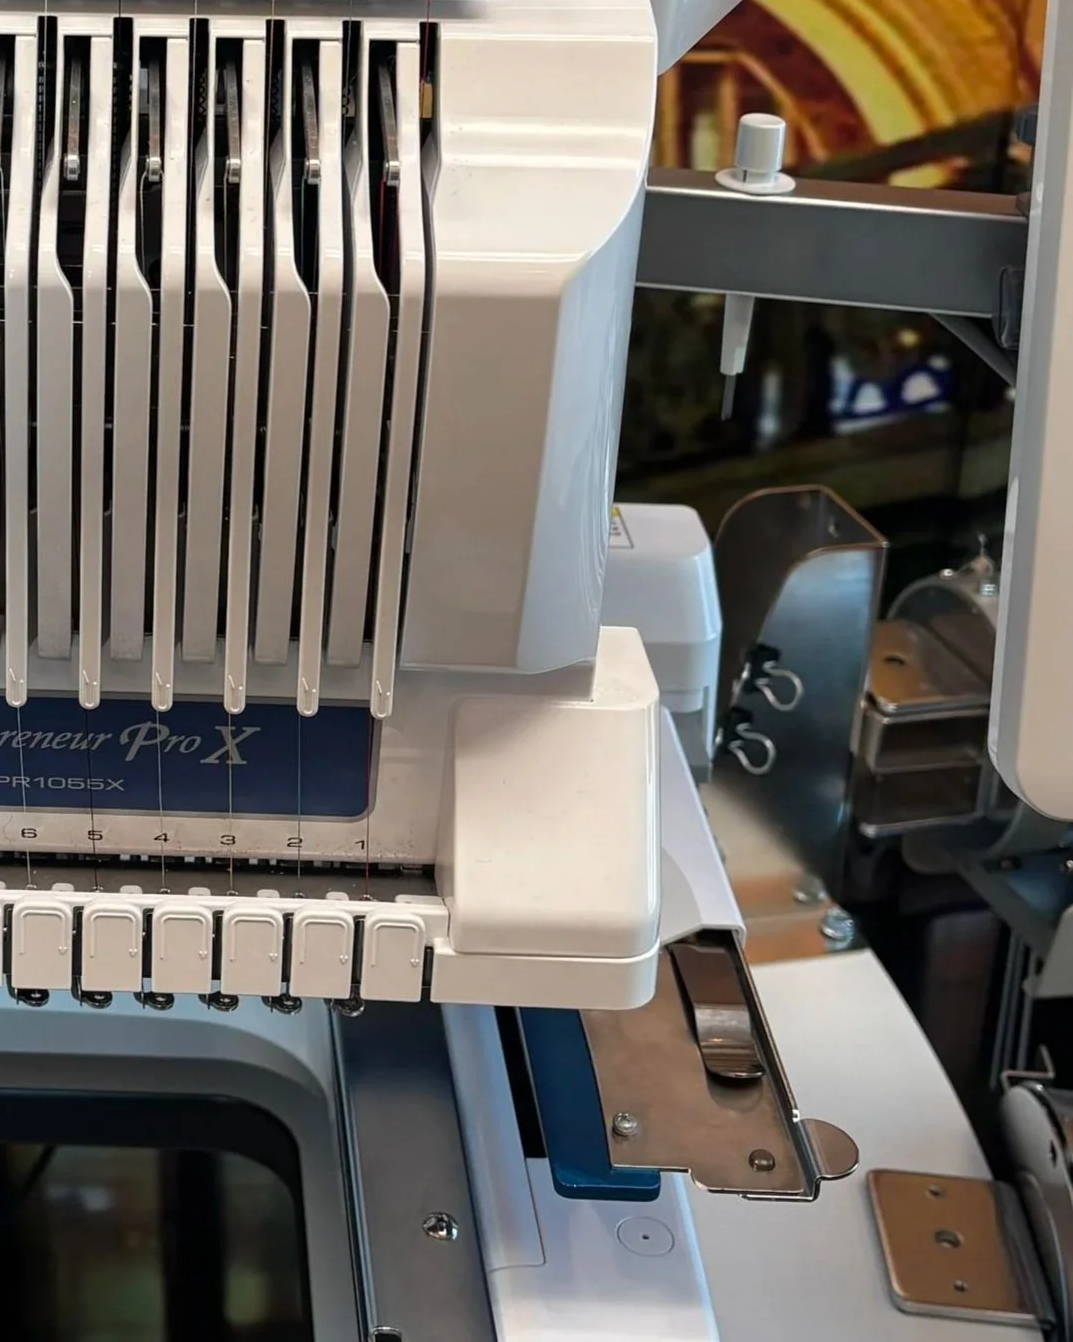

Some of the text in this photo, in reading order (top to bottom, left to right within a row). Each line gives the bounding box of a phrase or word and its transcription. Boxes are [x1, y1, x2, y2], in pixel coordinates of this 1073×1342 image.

[119, 722, 202, 762] Pro
[200, 726, 261, 765] X
[21, 827, 37, 839] 6
[87, 830, 103, 842] 5
[153, 832, 169, 843] 4
[220, 834, 237, 845] 3
[287, 836, 303, 848] 2
[355, 839, 366, 850] 1
